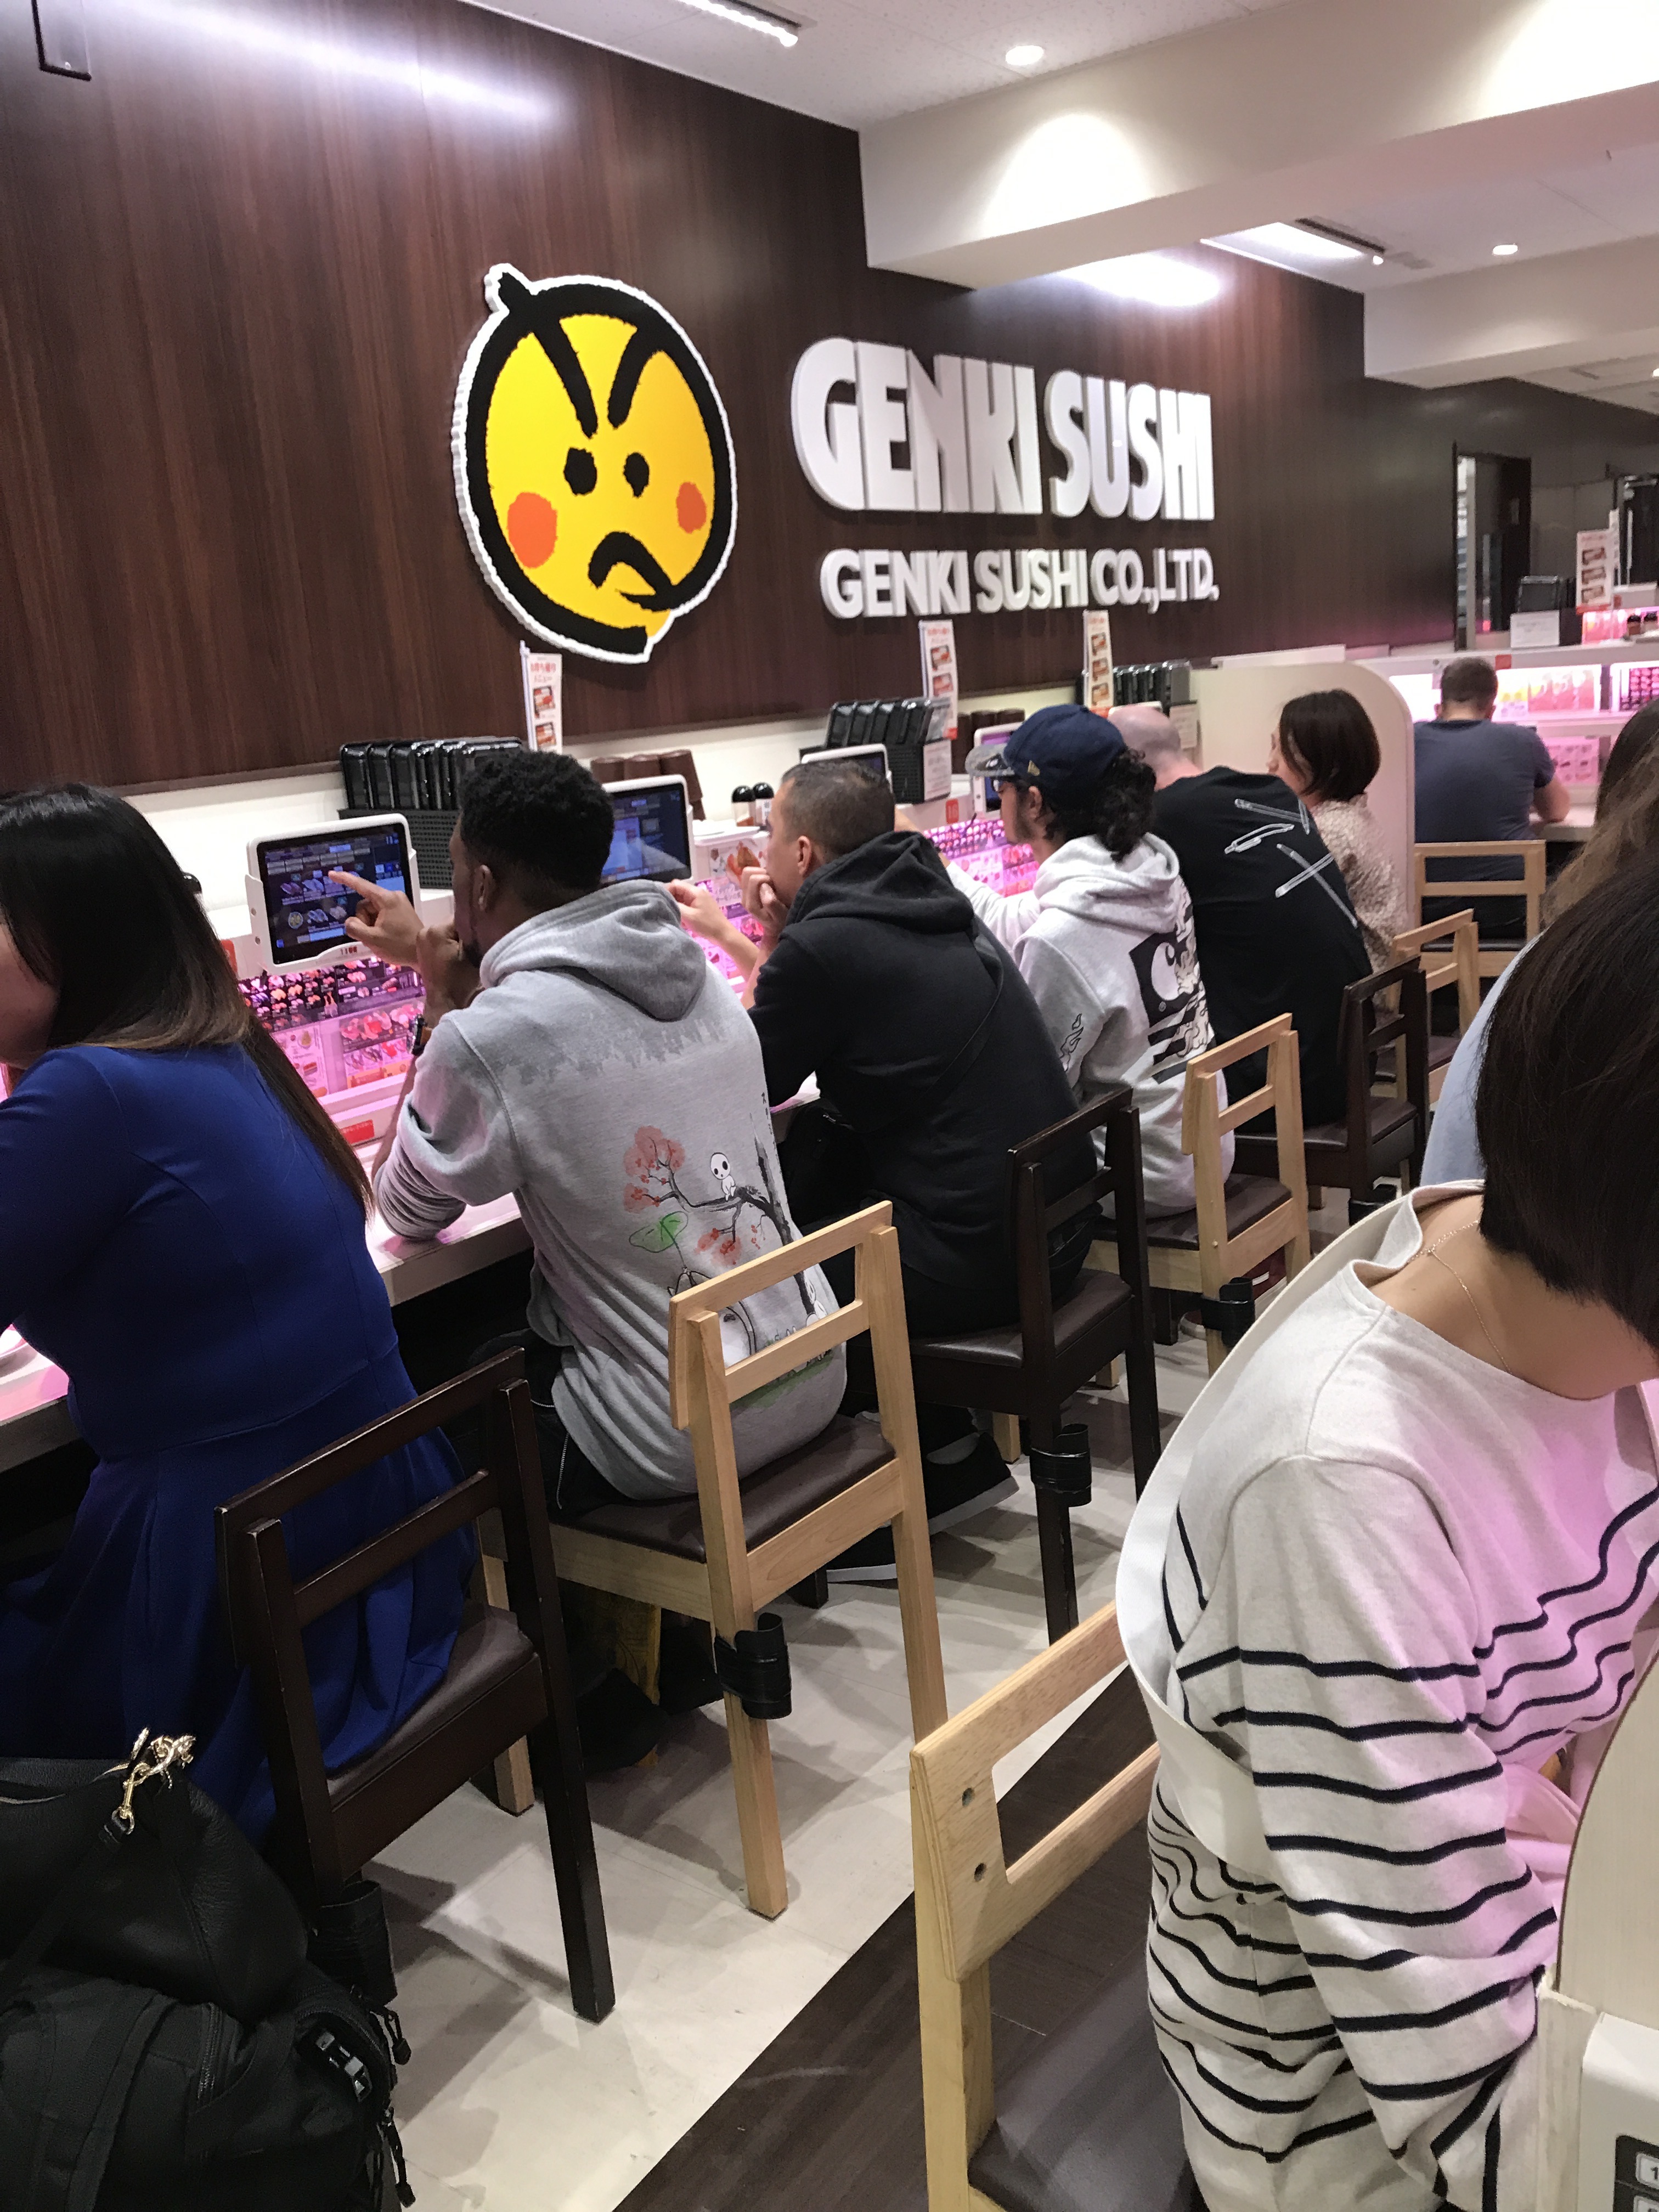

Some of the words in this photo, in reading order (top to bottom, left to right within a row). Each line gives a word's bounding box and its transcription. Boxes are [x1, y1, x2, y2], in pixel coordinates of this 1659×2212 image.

[791, 338, 1043, 514] GENKI
[1045, 370, 1215, 521] SUSHI
[820, 549, 971, 619] GENKI
[974, 548, 1089, 614] SUSHI
